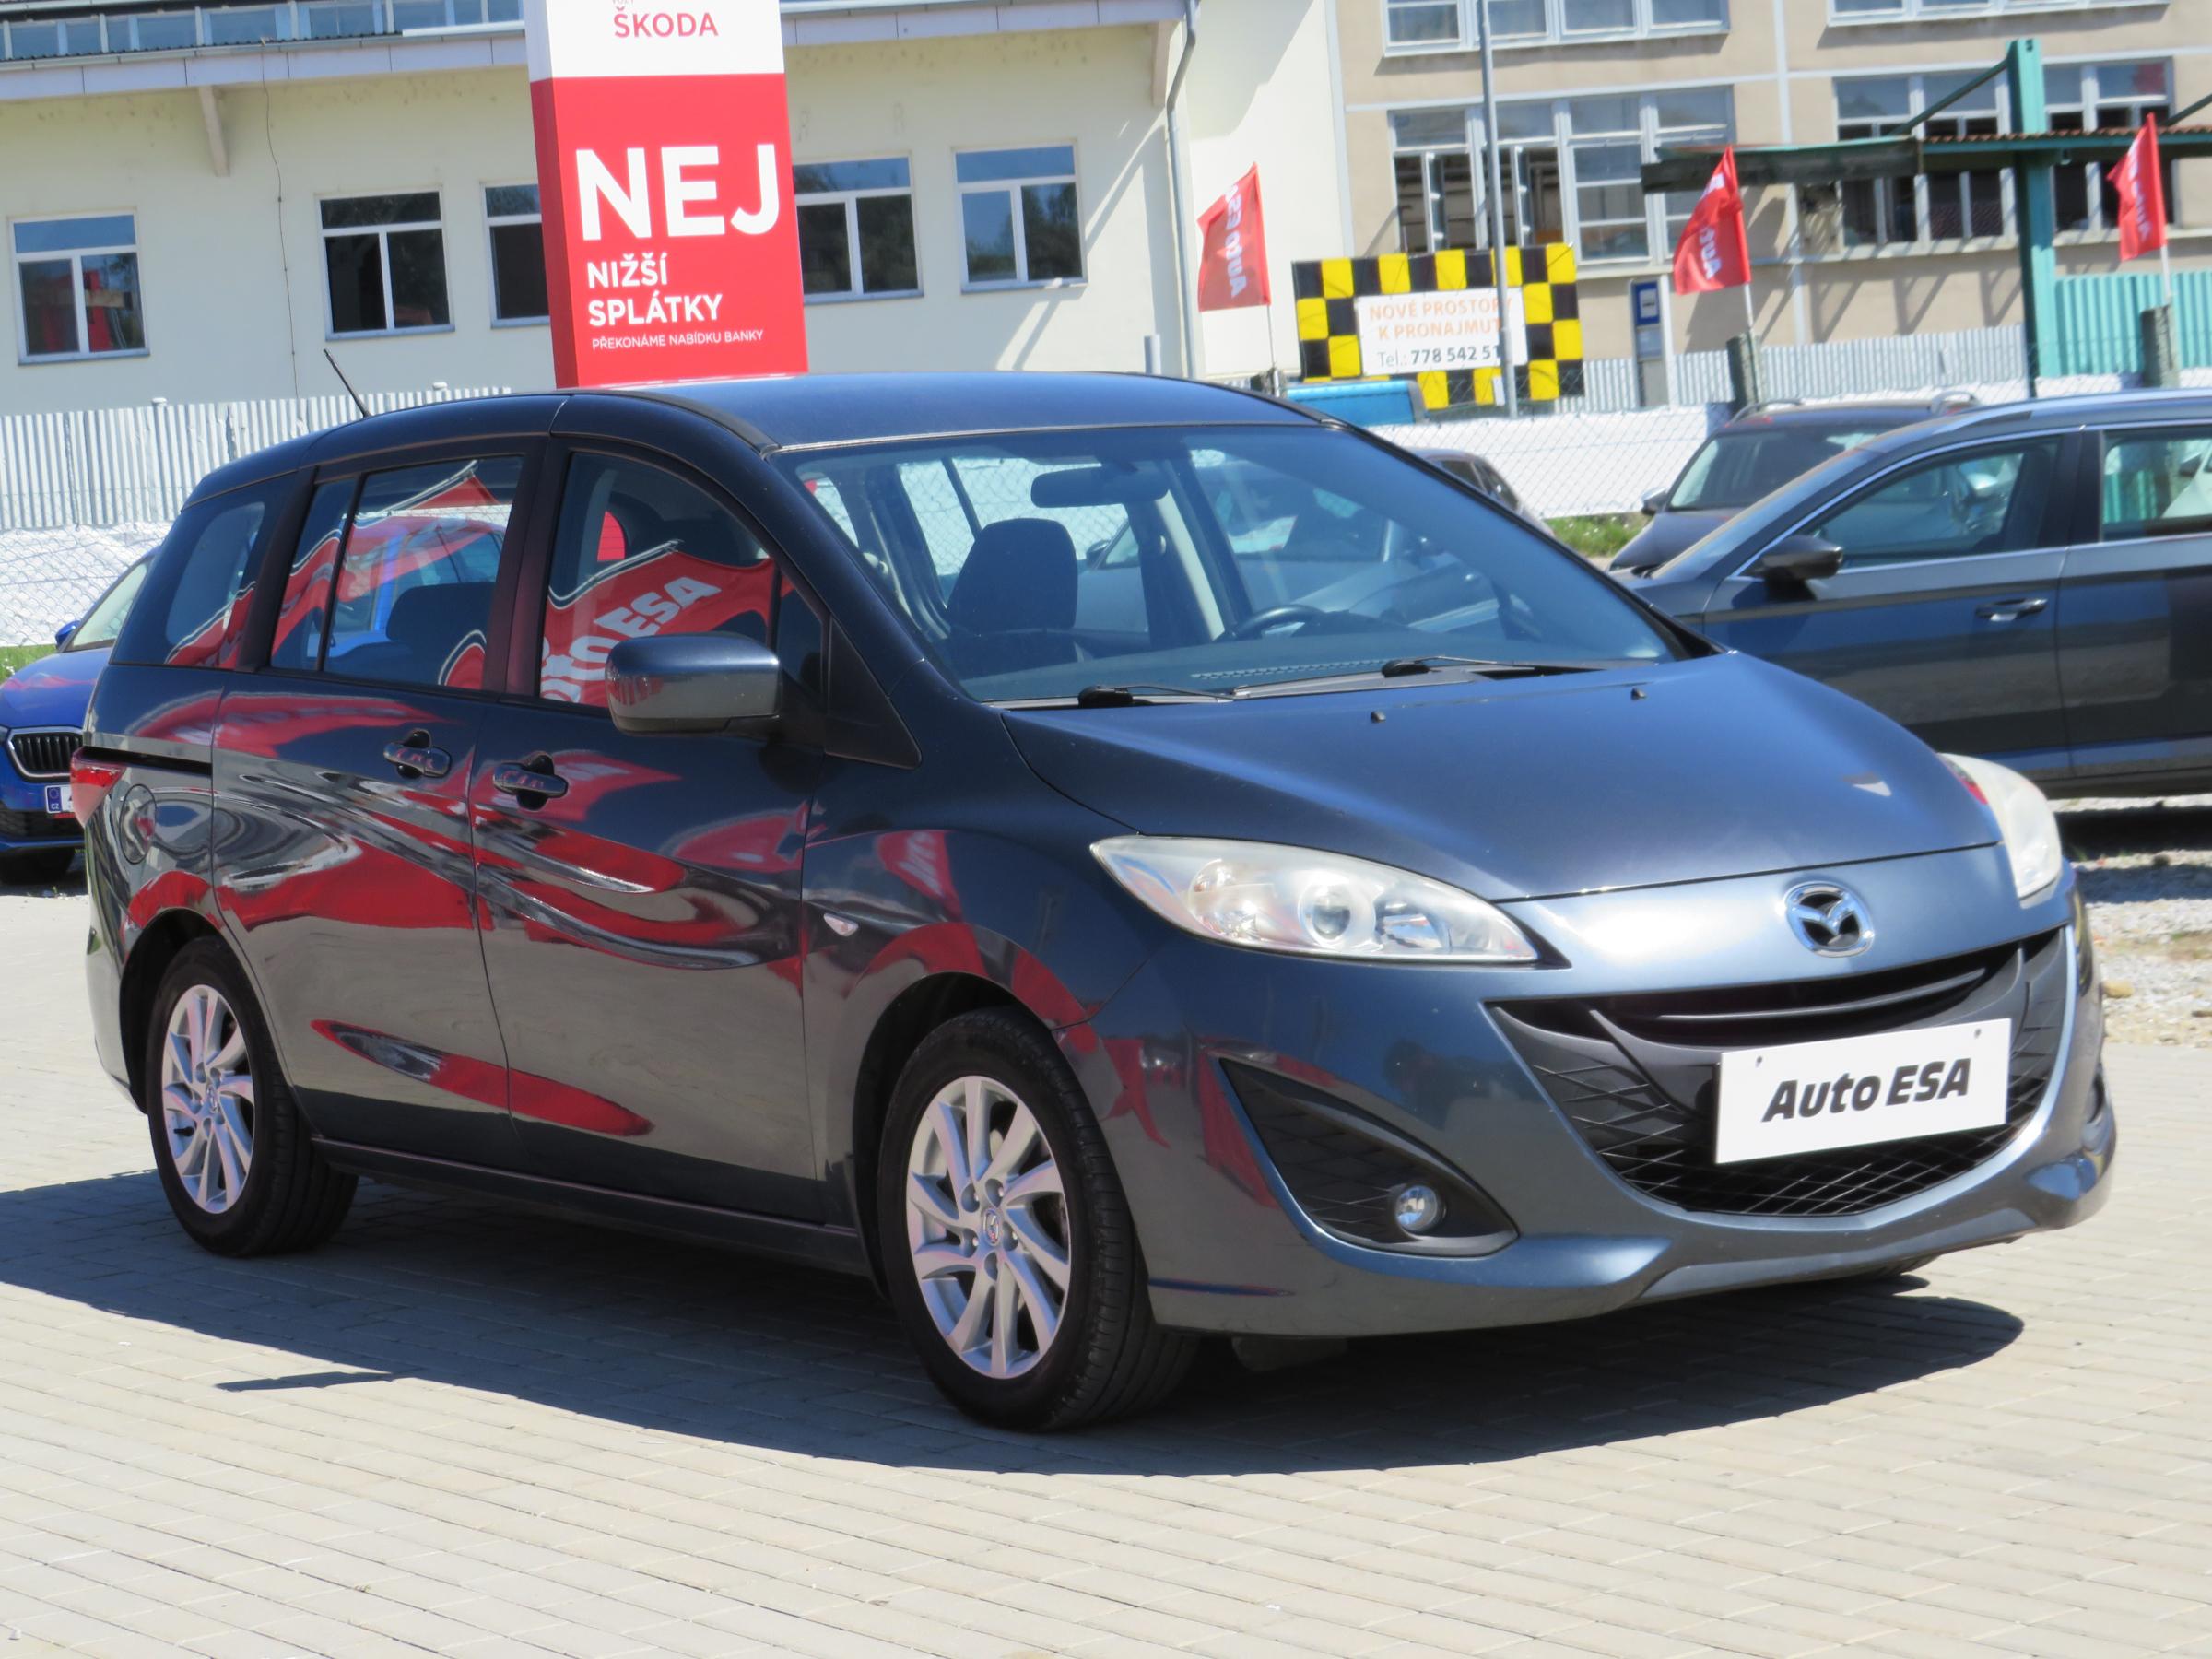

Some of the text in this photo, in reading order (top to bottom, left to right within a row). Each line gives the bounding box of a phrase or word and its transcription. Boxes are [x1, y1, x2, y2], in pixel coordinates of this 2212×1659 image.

[614, 5, 719, 38] ŠKODA
[575, 143, 780, 241] NEJ
[587, 252, 668, 288] NIŽŠÍ
[588, 290, 723, 326] SPLÁTKY
[1370, 300, 1418, 322] NOVÉ
[592, 329, 764, 350] PŘEKONÁME NABÍDKU BANKY
[1379, 325, 1389, 340] K
[1411, 348, 1442, 365] 778
[1447, 346, 1477, 362] 542
[1761, 1058, 1971, 1123] Auto ESA
